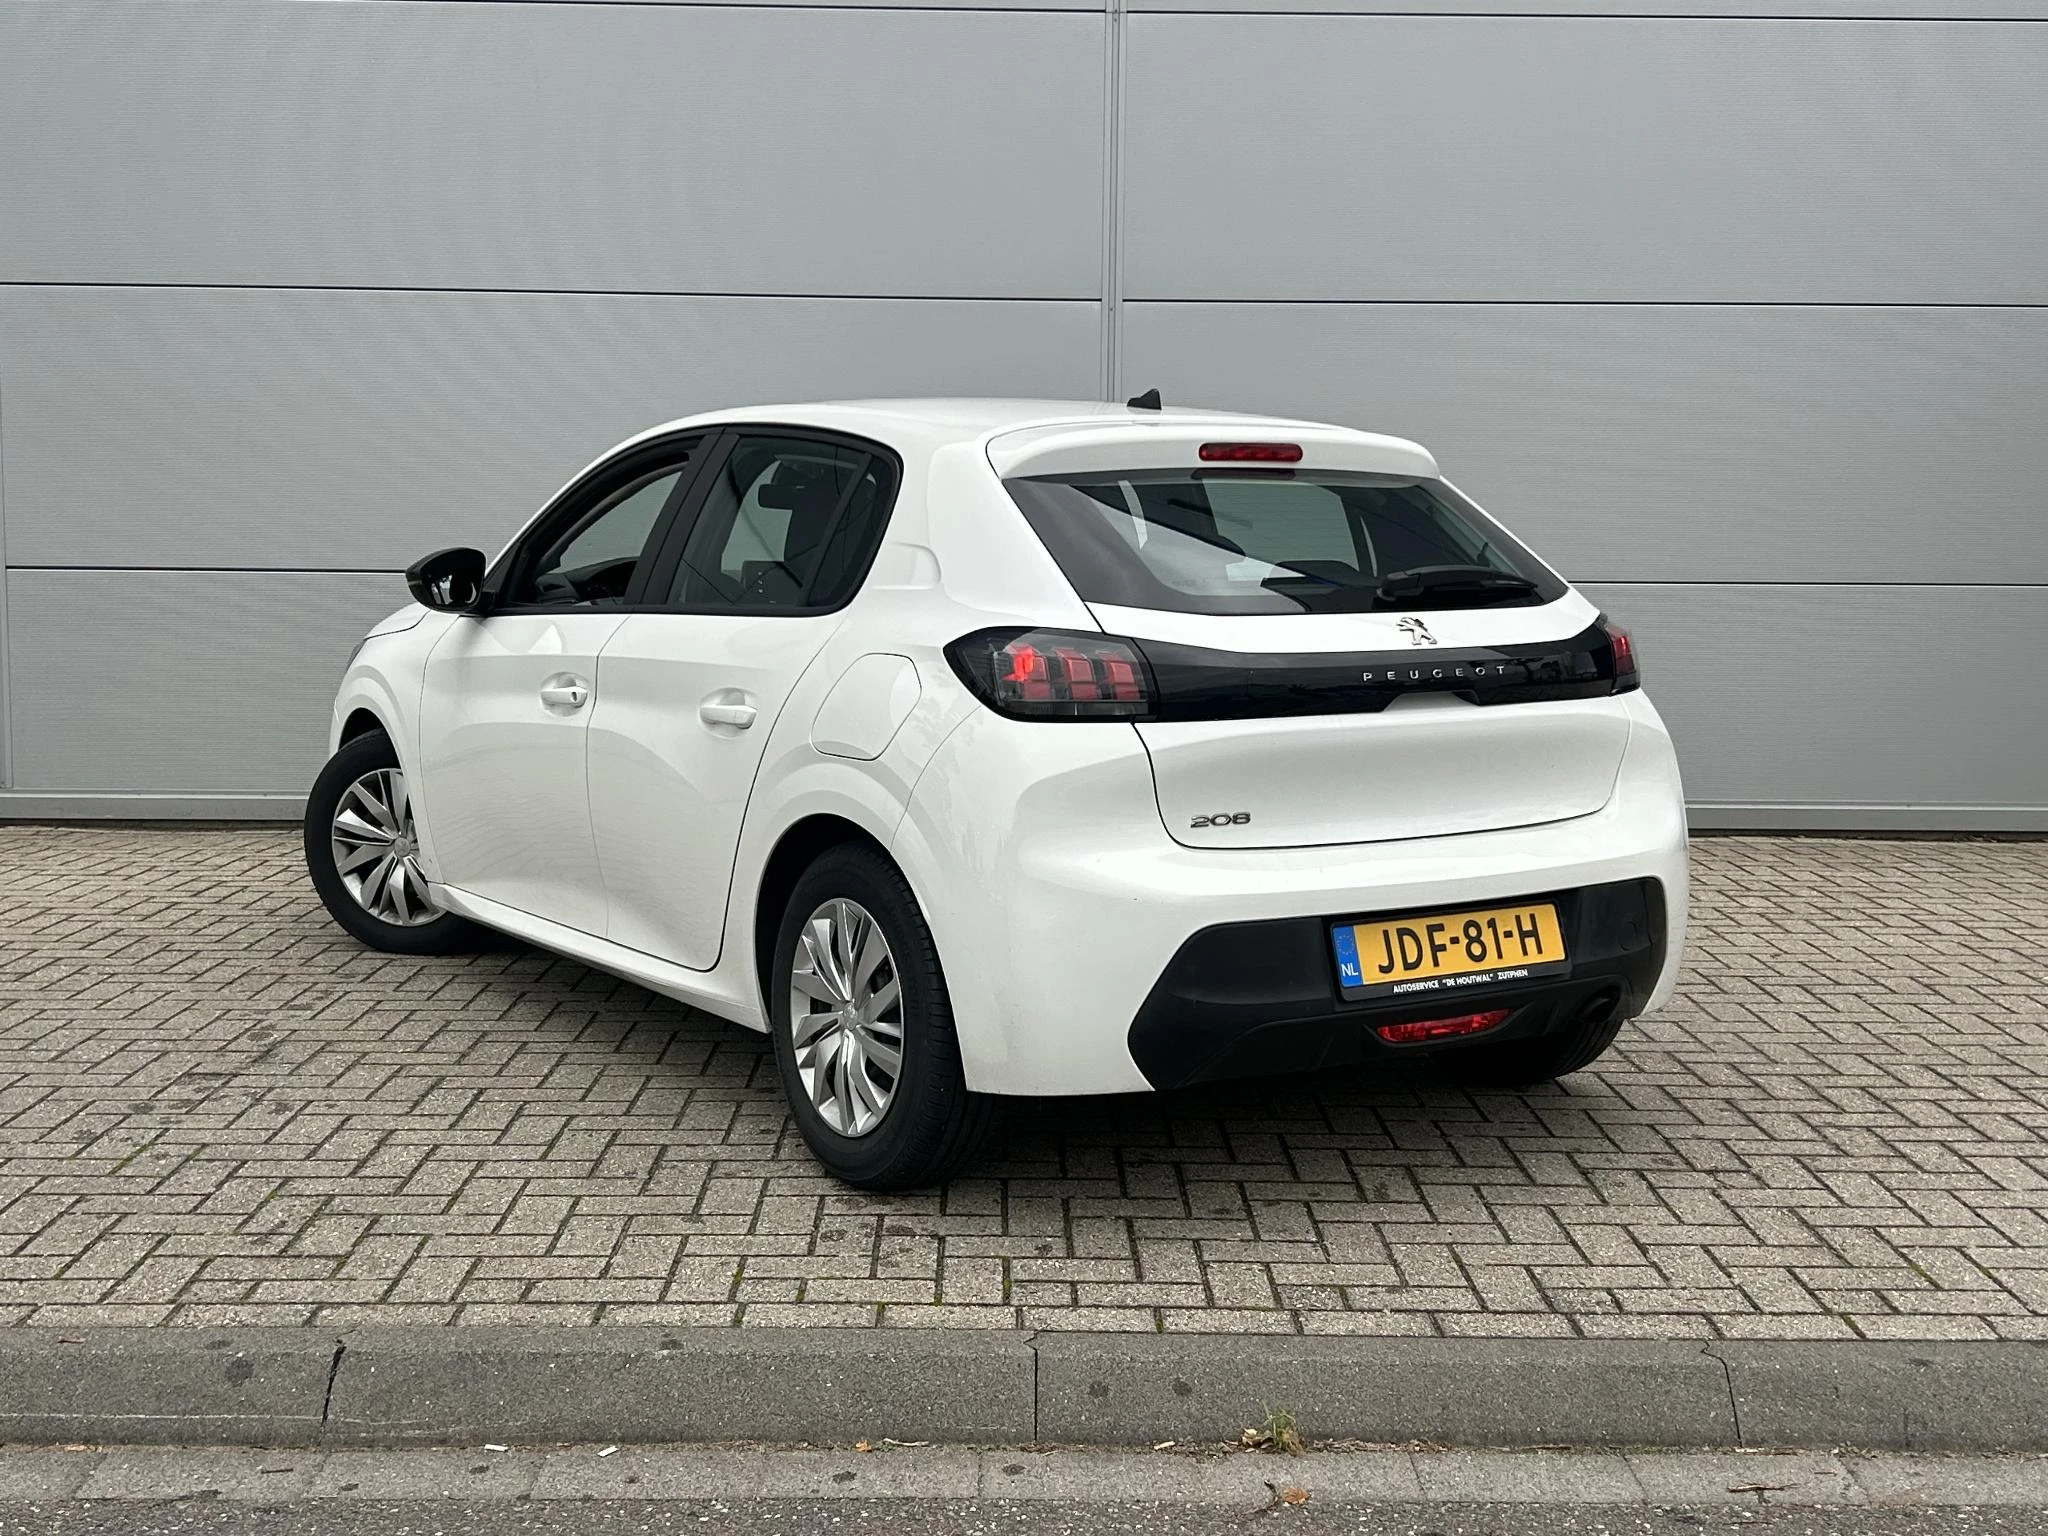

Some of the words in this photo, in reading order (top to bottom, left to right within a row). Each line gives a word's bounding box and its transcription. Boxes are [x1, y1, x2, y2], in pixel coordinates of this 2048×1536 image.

[1362, 665, 1505, 682] PEUGEOT
[1190, 812, 1251, 828] 208
[1378, 913, 1544, 974] JDF-81-H
[1341, 962, 1359, 977] NL
[1393, 980, 1440, 994] AUTOSERVICE
[1497, 969, 1529, 980] ZUTPHEN
